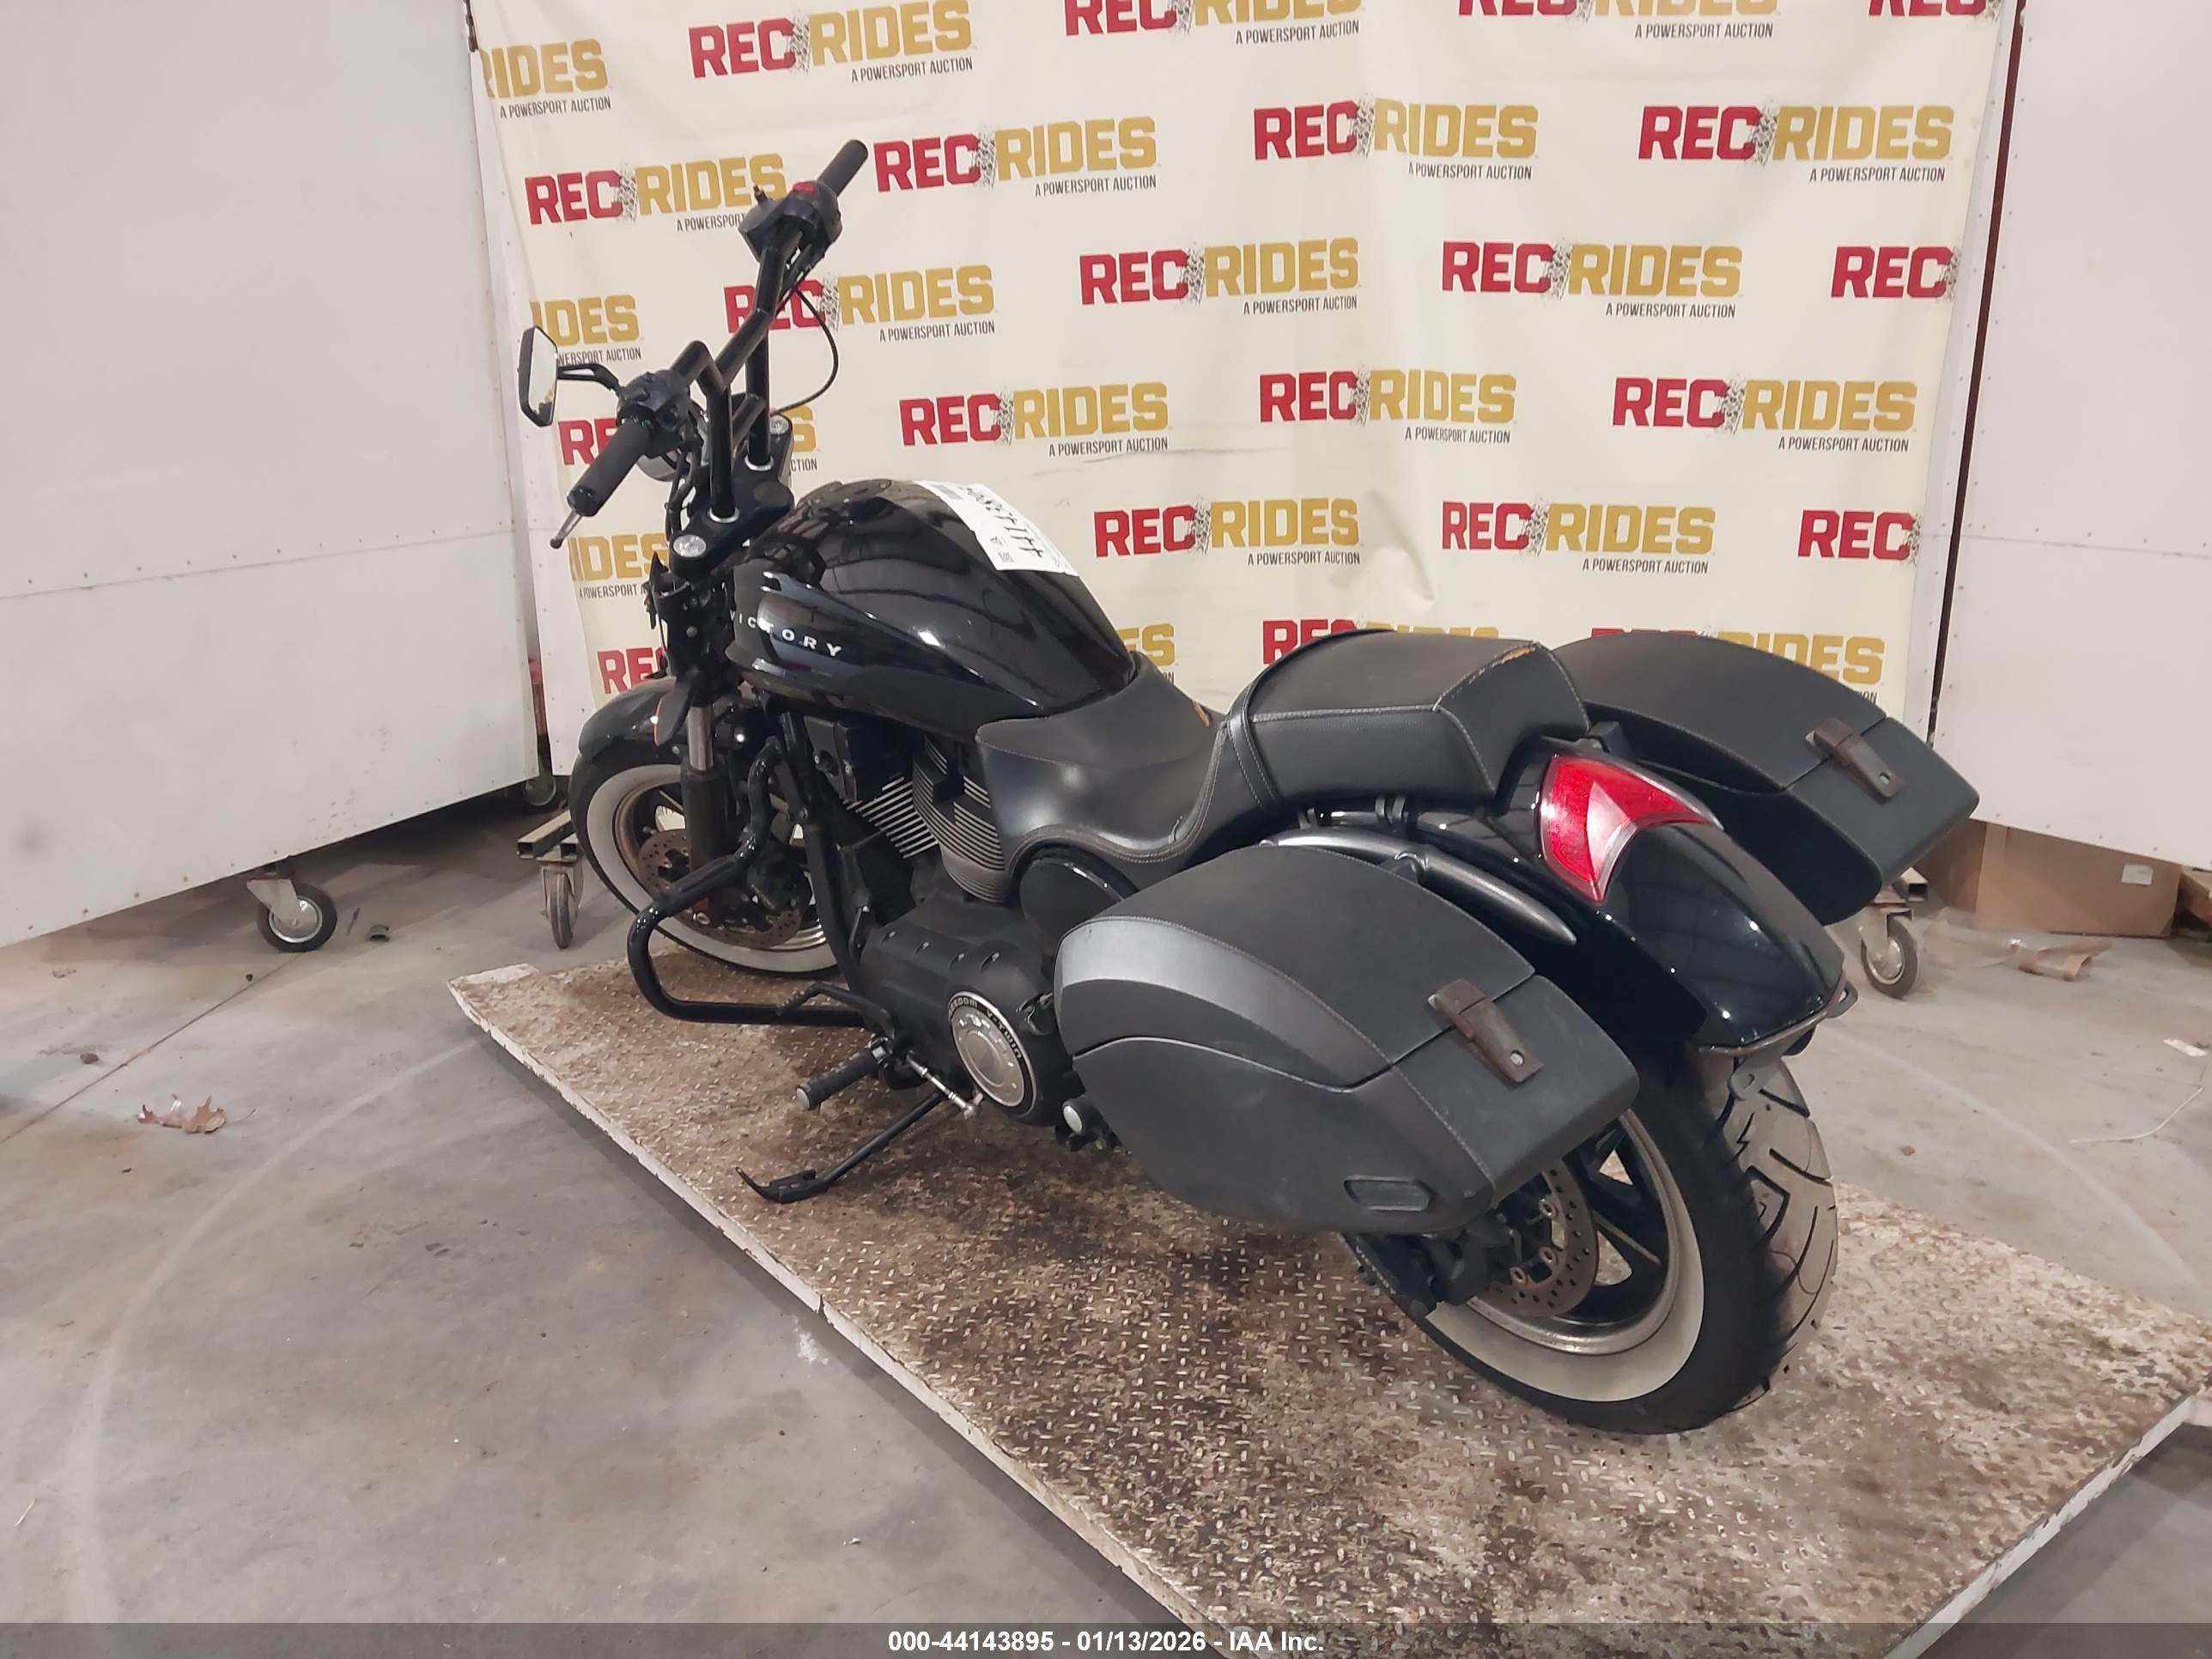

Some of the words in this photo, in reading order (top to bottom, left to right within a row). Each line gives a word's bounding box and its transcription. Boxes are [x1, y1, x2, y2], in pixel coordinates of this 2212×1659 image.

[689, 18, 796, 78] REC
[810, 0, 971, 65] RIDES
[1237, 33, 1243, 44] A
[1246, 27, 1315, 43] POWERSPORT
[1320, 20, 1359, 39] AUCTION
[1635, 24, 1642, 38] A
[1646, 24, 1721, 38] POWERSPORT
[1724, 24, 1772, 39] AUCTION
[851, 70, 859, 82] A
[860, 61, 927, 81] POWERSPORT
[929, 58, 972, 74] AUCTION
[500, 105, 507, 119] A
[509, 100, 567, 118] POWERSPORT
[571, 95, 611, 112] AUCTION
[1255, 102, 1358, 159] REC
[1374, 98, 1538, 158] RIDES
[1639, 107, 1761, 159] REC
[1773, 106, 1953, 160] RIDES
[874, 135, 980, 191] REC
[994, 117, 1157, 179] RIDES
[1409, 161, 1414, 175] A
[1416, 163, 1482, 178] POWERSPORT
[1486, 165, 1531, 179] AUCTION
[525, 170, 623, 225] REC
[635, 155, 787, 214] RIDES
[1036, 184, 1041, 196] A
[1043, 179, 1109, 194] POWERSPORT
[1114, 174, 1156, 190] AUCTION
[1809, 167, 1817, 182] A
[1820, 167, 1896, 182] POWERSPORT
[1899, 167, 1944, 182] AUCTION
[677, 218, 684, 231] A
[1080, 251, 1188, 304] REC
[1204, 238, 1358, 296] RIDES
[1442, 240, 1554, 294] REC
[1568, 244, 1741, 296] RIDES
[1832, 247, 1953, 297] REC
[838, 265, 994, 324] RIDES
[1243, 302, 1250, 314] A
[1254, 299, 1320, 313] POWERSPORT
[1323, 295, 1357, 310] AUCTION
[1606, 303, 1613, 316] A
[1616, 303, 1686, 317] POWERSPORT
[1689, 304, 1735, 318] AUCTION
[529, 295, 640, 347] IDES
[879, 329, 885, 341] A
[887, 324, 951, 339] POWERSPORT
[953, 320, 994, 335] AUCTION
[558, 351, 603, 364] WERSPORT
[606, 348, 641, 362] AUCTION
[1261, 372, 1358, 422] REC
[1367, 371, 1516, 422] RIDES
[1613, 379, 1728, 427] REC
[1742, 380, 1917, 431] RIDES
[900, 394, 1000, 445] REC
[1012, 384, 1168, 439] RIDES
[1048, 444, 1055, 456] A
[1058, 440, 1122, 456] POWERSPORT
[1126, 437, 1168, 452] AUCTION
[1405, 427, 1413, 441] A
[1415, 427, 1467, 442] POWERSPORT
[1469, 430, 1510, 443] AUCTION
[1778, 437, 1785, 450] A
[1788, 438, 1858, 451] POWERSPORT
[1863, 439, 1908, 452] AUCTION
[791, 459, 817, 472] CTION
[1095, 506, 1195, 556] REC
[1209, 498, 1358, 548] RIDES
[1443, 502, 1532, 550] REC
[1546, 504, 1715, 554] RIDES
[1799, 511, 1915, 560] REC
[1249, 554, 1254, 565] A
[1256, 551, 1321, 565] POWERSPORT
[1324, 551, 1360, 565] AUCTION
[1583, 558, 1589, 571] A
[1592, 558, 1662, 572] POWERSPORT
[1664, 560, 1708, 573] AUCTION
[730, 609, 842, 657] VICTORY
[597, 647, 662, 694] RE
